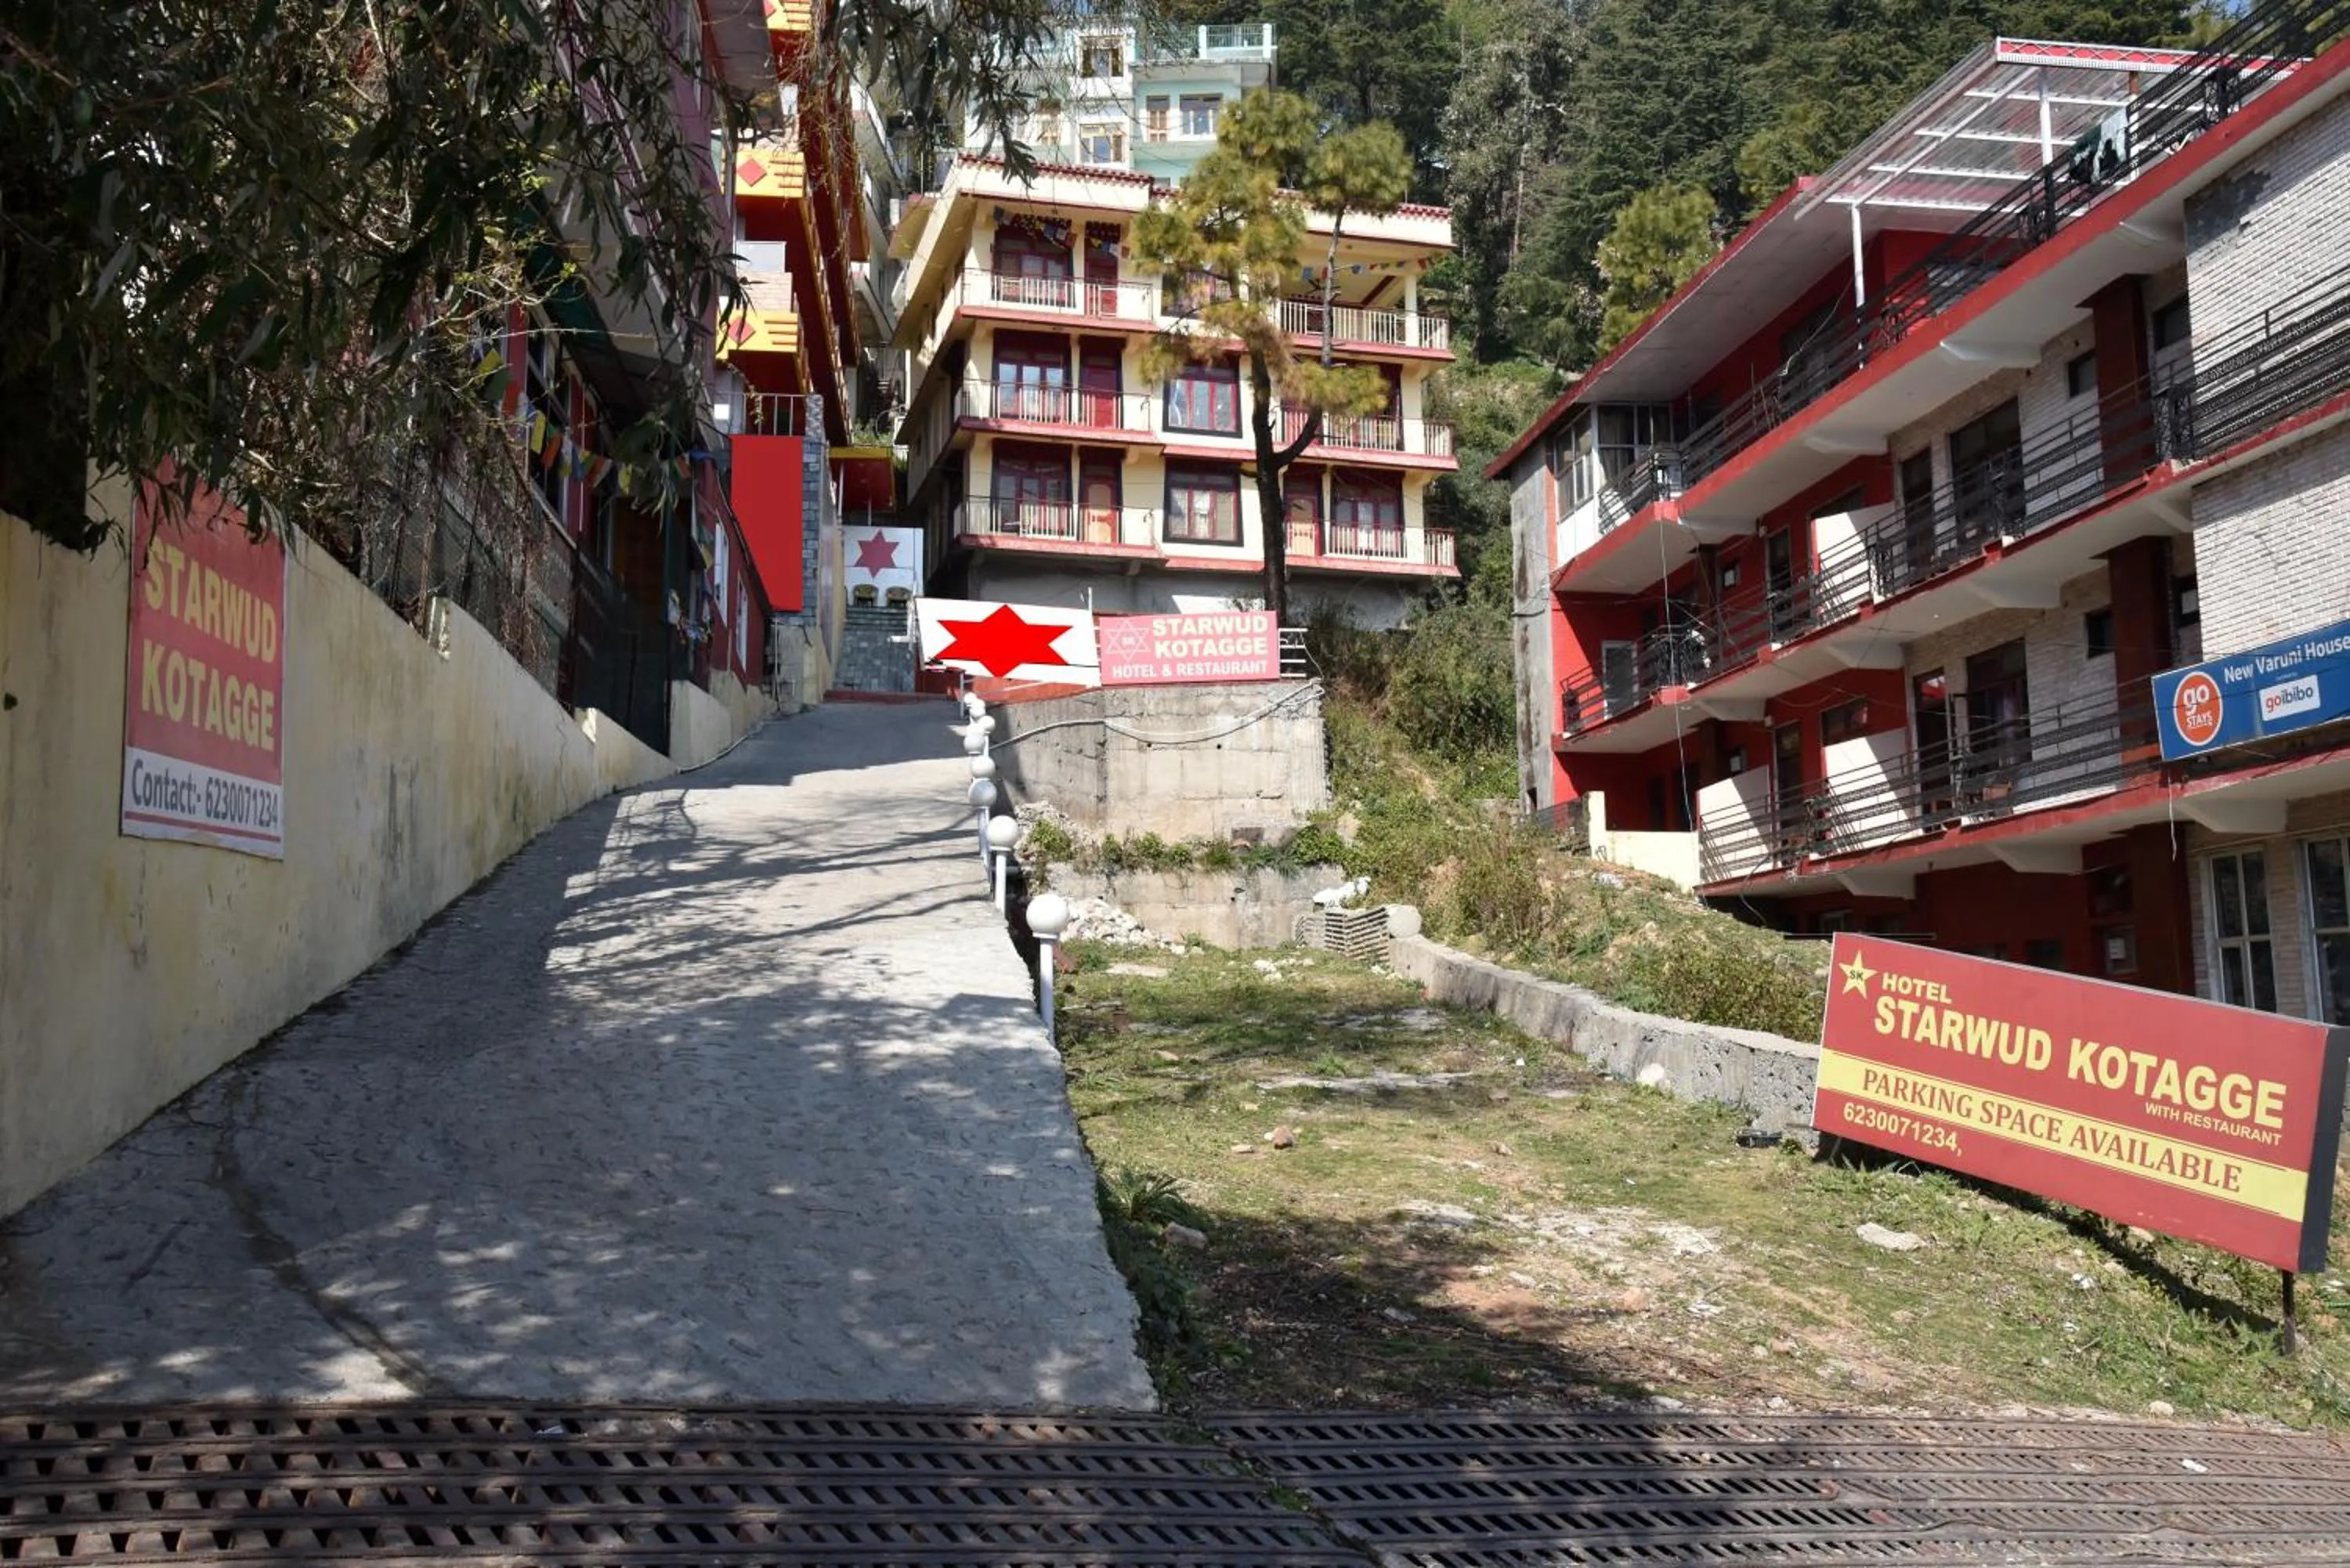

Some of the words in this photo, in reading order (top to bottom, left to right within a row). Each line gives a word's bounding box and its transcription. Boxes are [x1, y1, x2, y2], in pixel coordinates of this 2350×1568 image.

[143, 537, 277, 663] STARWUD
[1153, 616, 1267, 636] STARWUD
[1155, 638, 1267, 659] KOTAGGE
[2225, 664, 2254, 683] New
[2256, 645, 2302, 674] Varuni
[1112, 664, 1156, 678] HOTEL
[1162, 663, 1172, 677] &
[1177, 660, 1267, 677] RESTAURANT
[141, 638, 276, 752] KOTAGGE
[2183, 685, 2210, 717] go
[2265, 685, 2314, 714] goibibo
[205, 776, 279, 829] 6230071234
[1882, 971, 1953, 1005] HOTEL
[1875, 995, 2052, 1071] STARWUD
[2067, 1037, 2287, 1129] KOTAGGE
[1862, 1068, 1973, 1119] PARKING
[1979, 1099, 2063, 1144] SPACE
[2068, 1124, 2243, 1194] AVAILABLE
[2145, 1101, 2181, 1122] WITH
[2182, 1111, 2283, 1147] RESTAURANT
